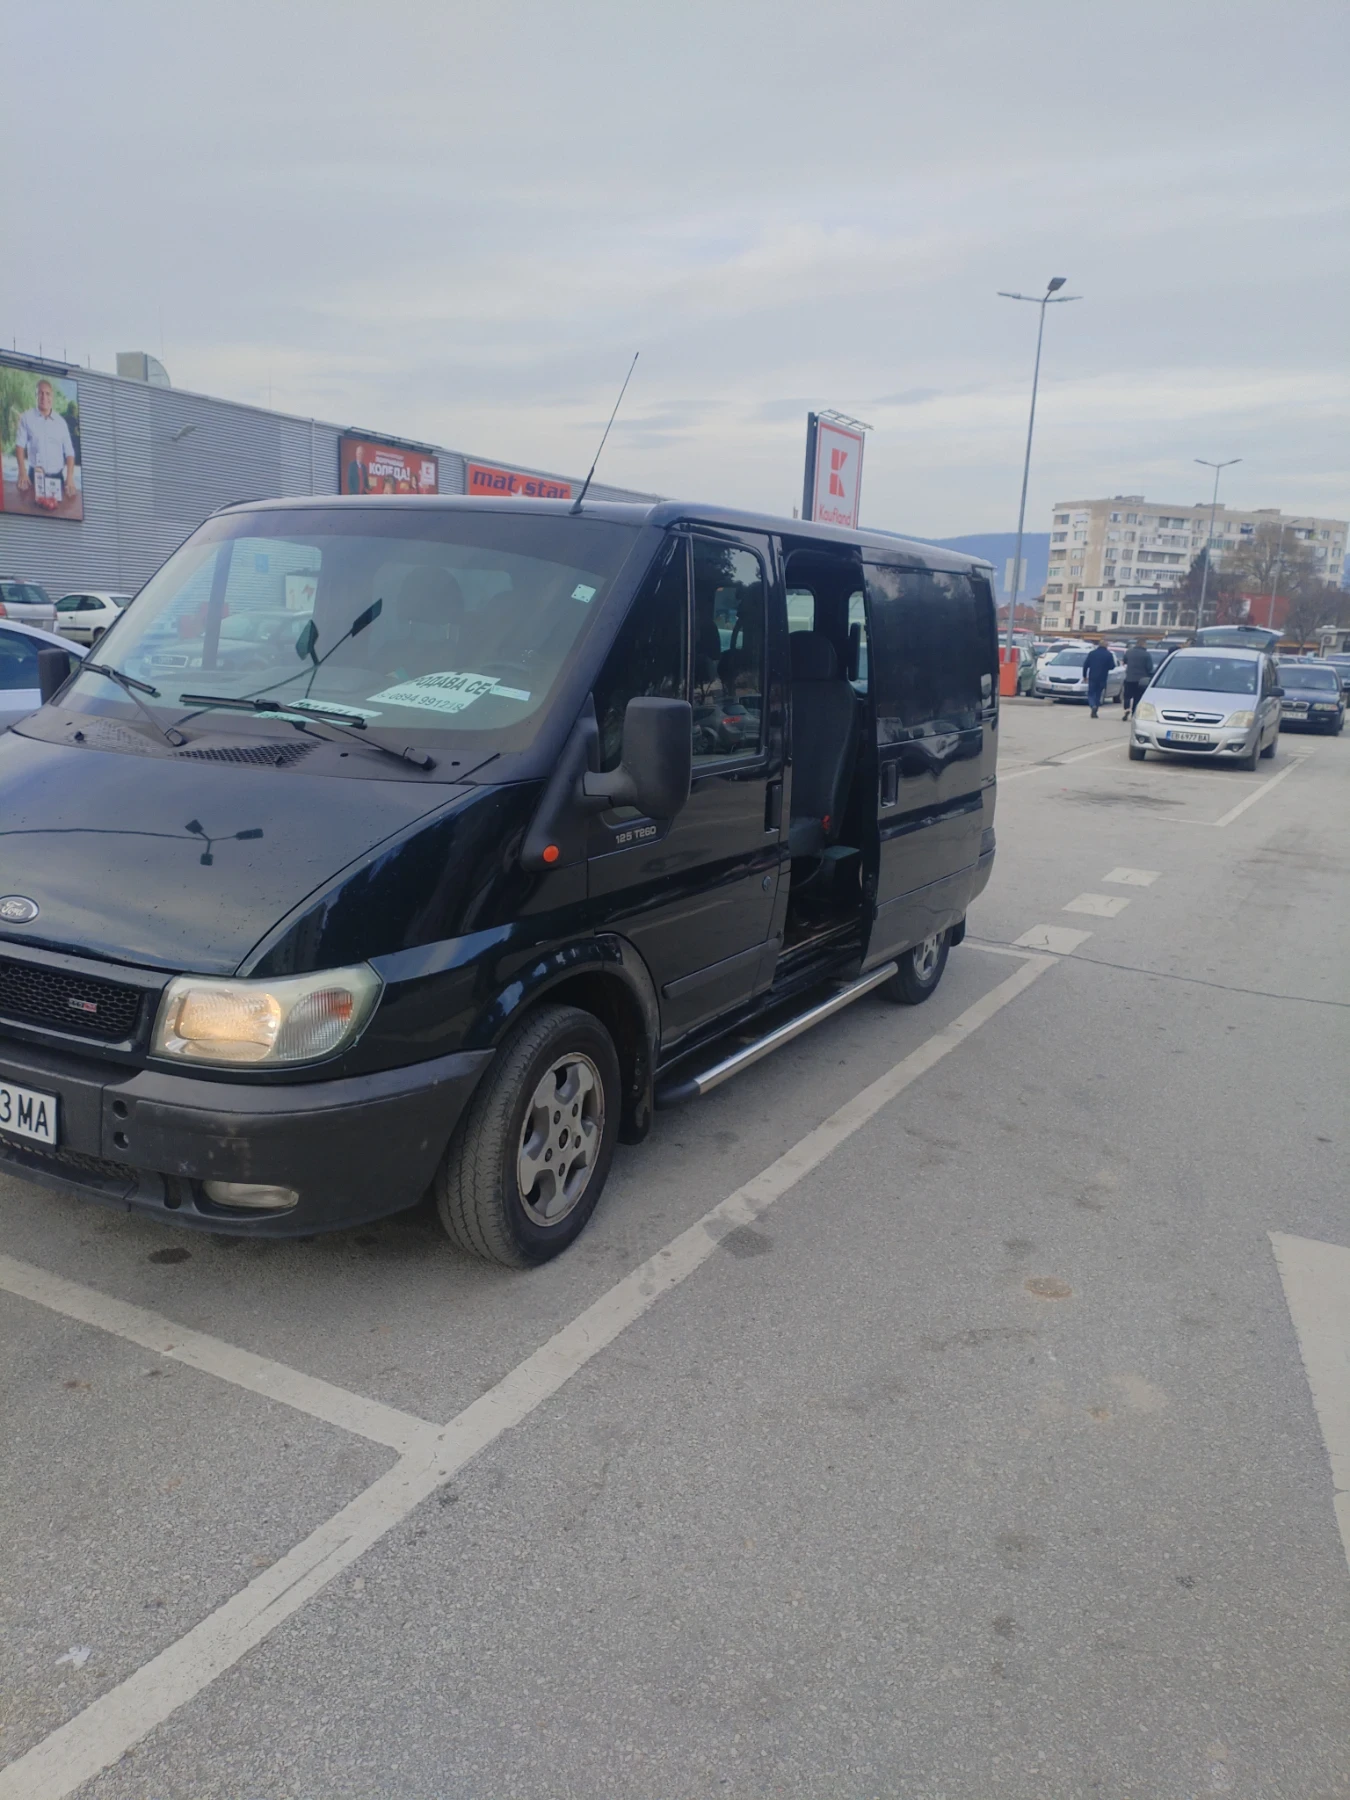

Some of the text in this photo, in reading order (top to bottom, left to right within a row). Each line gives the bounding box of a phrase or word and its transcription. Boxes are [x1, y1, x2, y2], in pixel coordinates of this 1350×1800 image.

[473, 470, 568, 499] mat star
[408, 676, 492, 695] ОДАВА СЕ
[616, 825, 657, 844] 125 T260
[1, 900, 26, 916] Ford
[18, 1093, 49, 1137] MA
